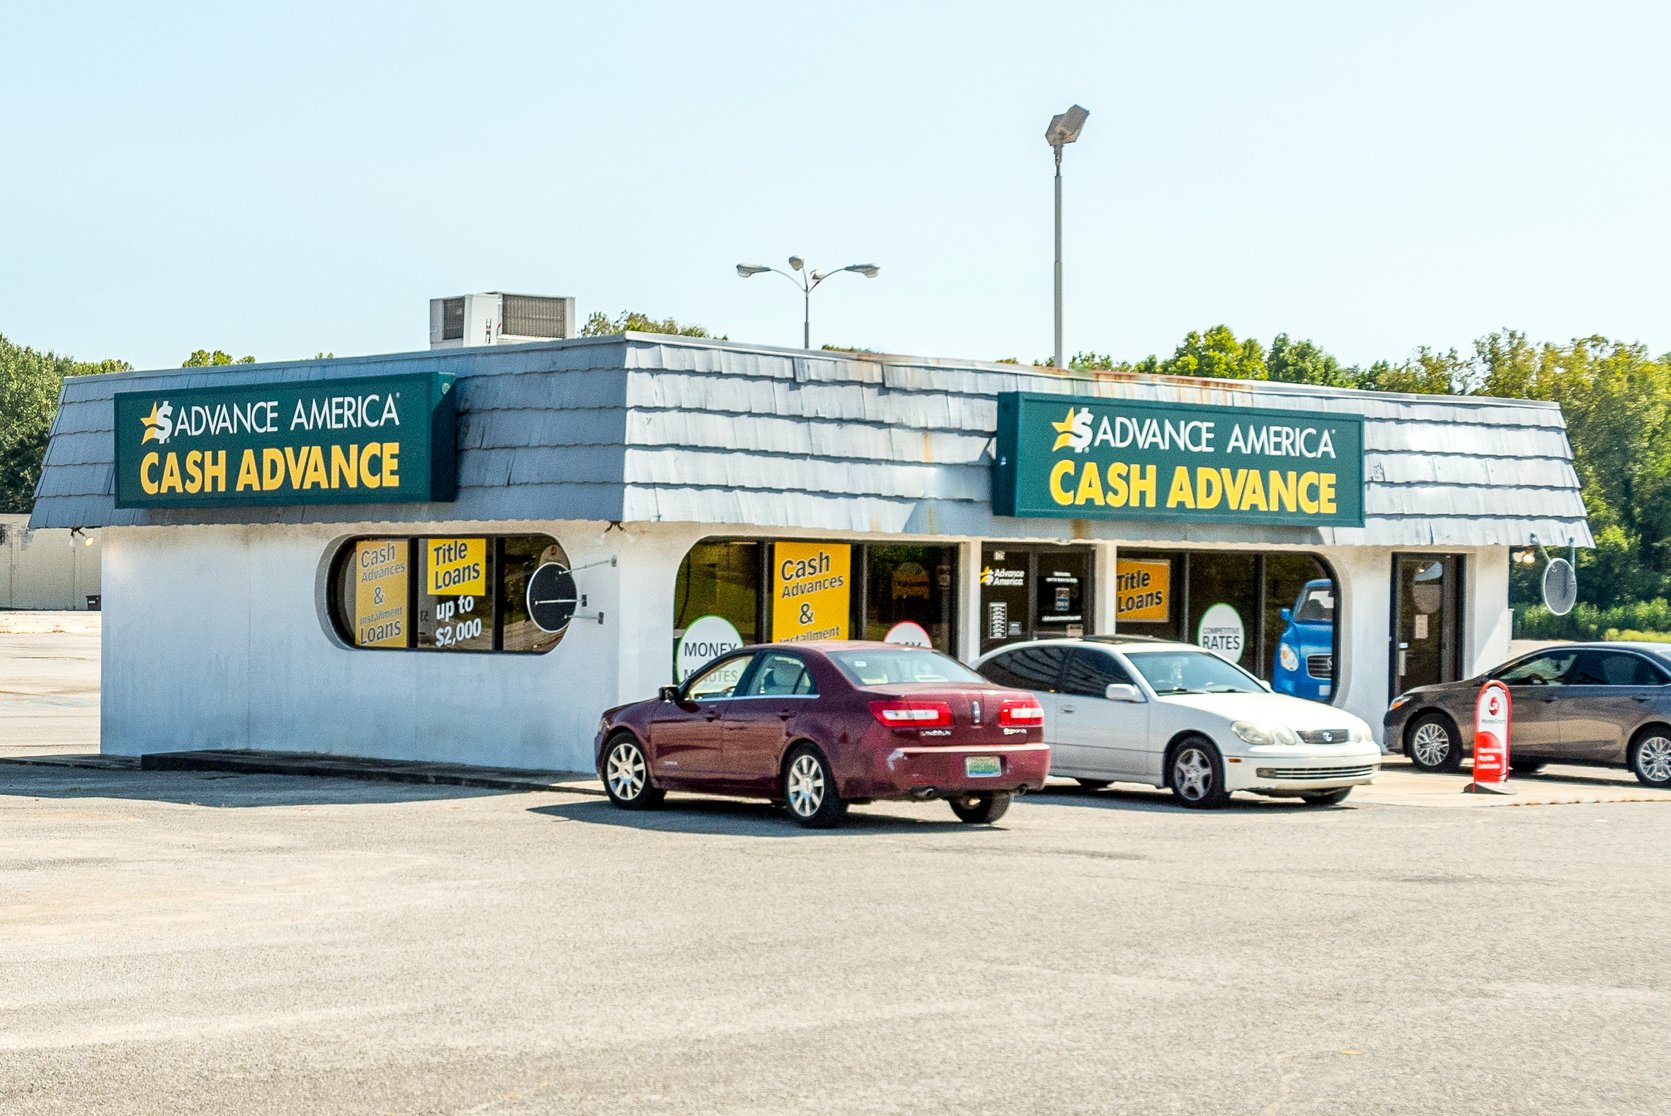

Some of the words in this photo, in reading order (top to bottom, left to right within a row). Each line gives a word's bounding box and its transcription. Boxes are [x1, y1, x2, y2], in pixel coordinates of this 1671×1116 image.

[174, 401, 278, 436] ADVANCE
[290, 393, 400, 431] AMERICA
[1094, 415, 1215, 452] ADVANCE
[1226, 422, 1337, 459] AMERICA
[140, 450, 226, 495] CASH
[235, 442, 400, 491] ADVANCE
[1050, 459, 1157, 508] CASH
[1166, 465, 1337, 514] ADVANCE
[361, 543, 396, 568] Cash
[433, 540, 468, 566] Title
[361, 562, 405, 583] Advances
[435, 562, 481, 590] Loans
[781, 551, 831, 582] Cash
[994, 568, 1025, 578] Advance
[781, 574, 844, 599] Advances
[992, 577, 1024, 586] America
[1117, 570, 1151, 592] Title
[373, 587, 384, 605] &
[436, 600, 455, 622] up
[458, 595, 475, 614] to
[1118, 590, 1163, 613] Loans
[799, 603, 814, 625] &
[360, 621, 402, 645] Loans
[435, 617, 482, 648] $2,000
[1203, 627, 1240, 635] COMPETITIVE
[1203, 635, 1240, 650] RATES
